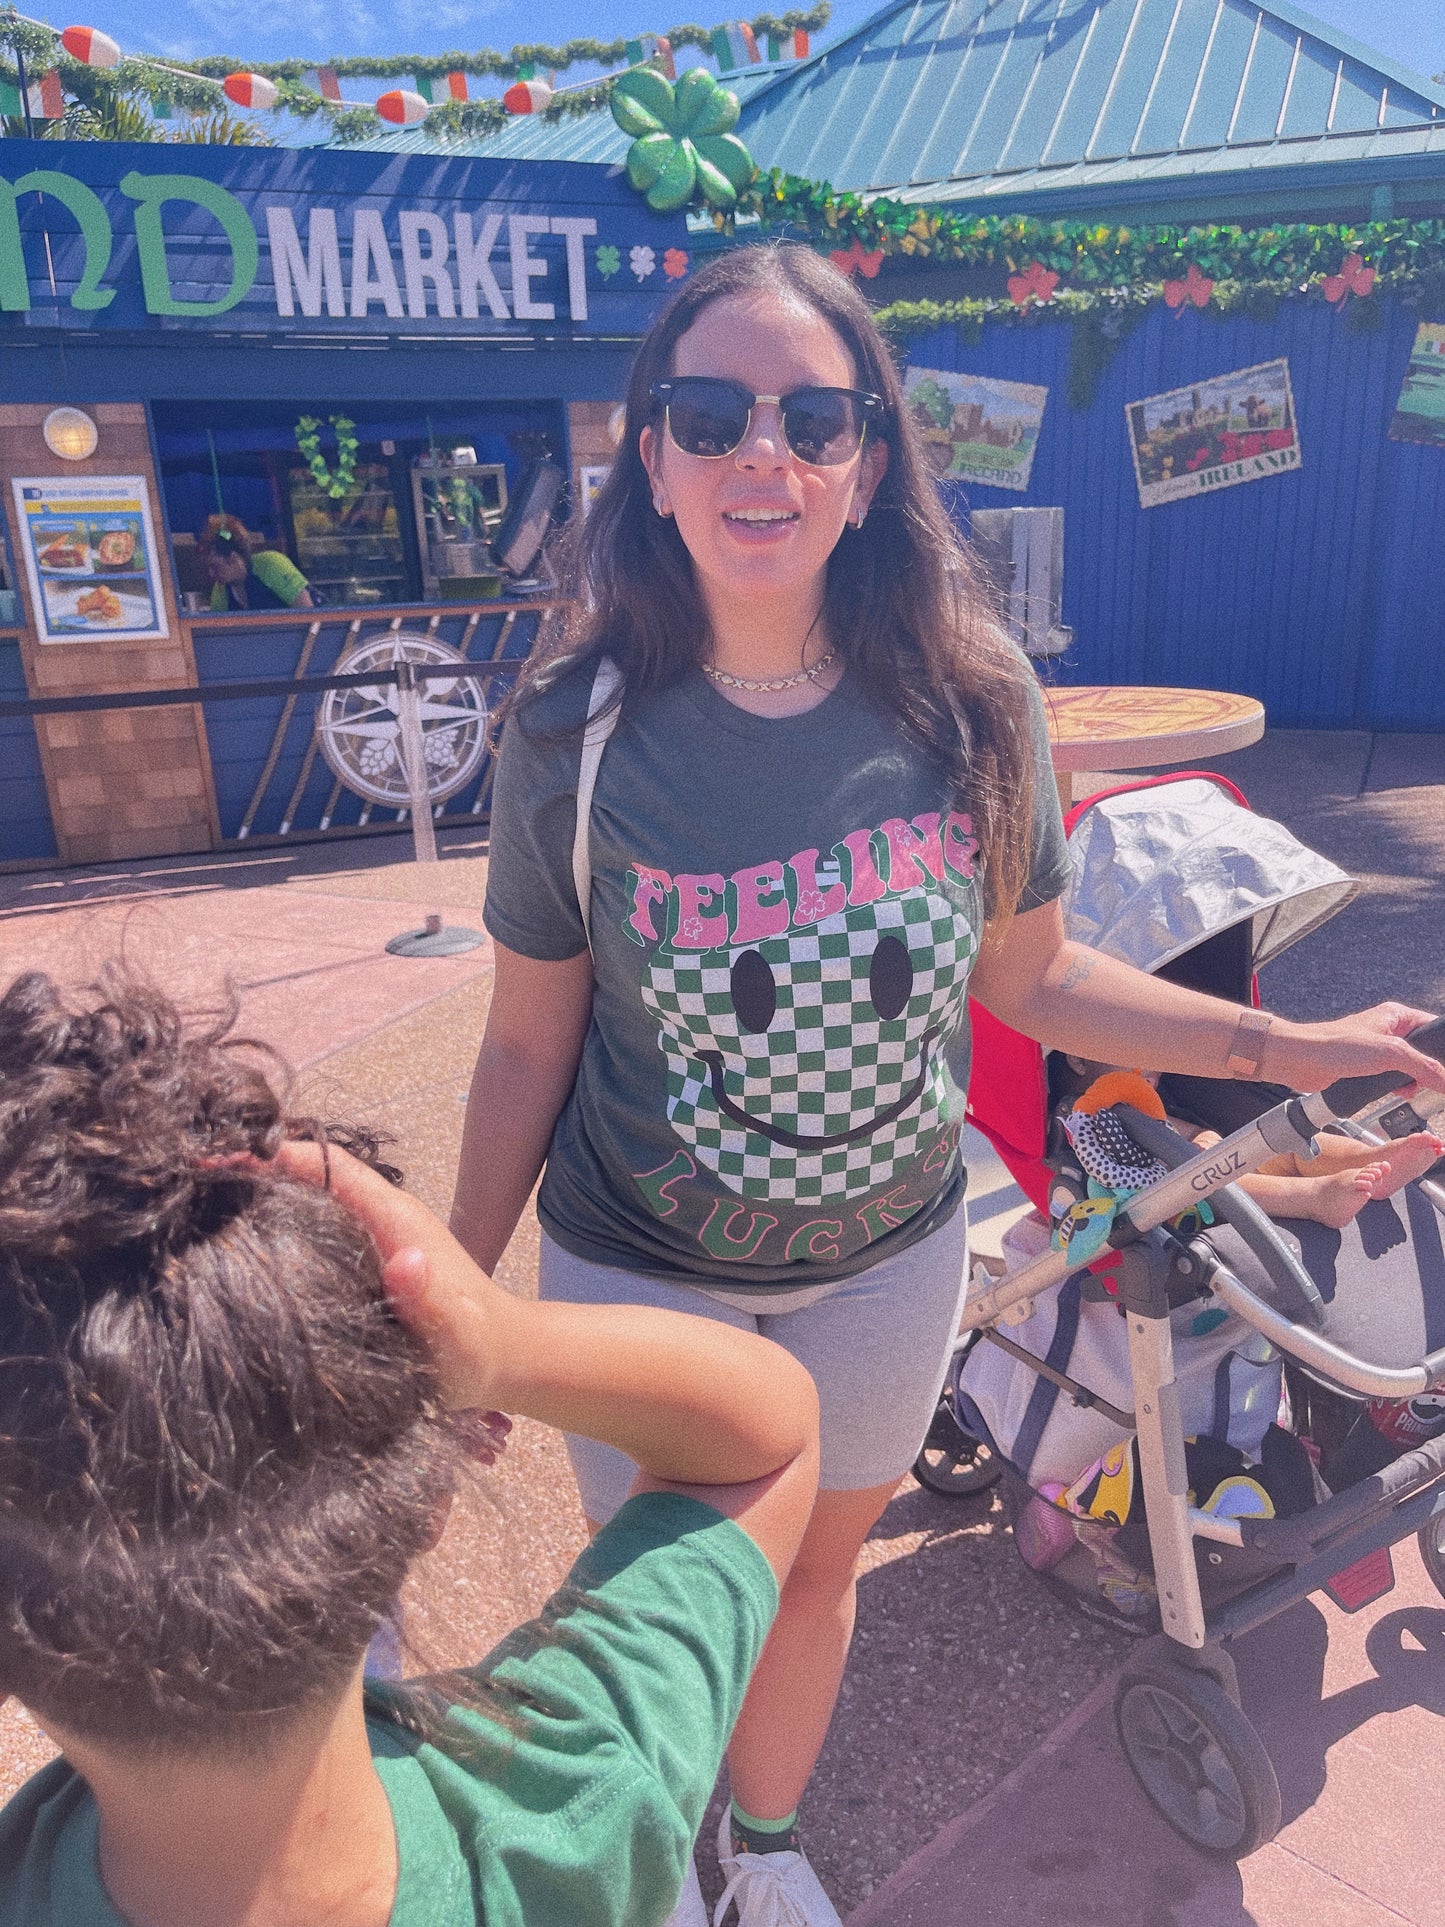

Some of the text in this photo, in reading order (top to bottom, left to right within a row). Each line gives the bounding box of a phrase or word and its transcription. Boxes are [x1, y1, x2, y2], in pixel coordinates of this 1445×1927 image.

[266, 206, 598, 321] MARKET
[1199, 450, 1297, 487] IRELAND
[622, 812, 979, 955] FEELING
[1190, 1150, 1247, 1191] CRUZ
